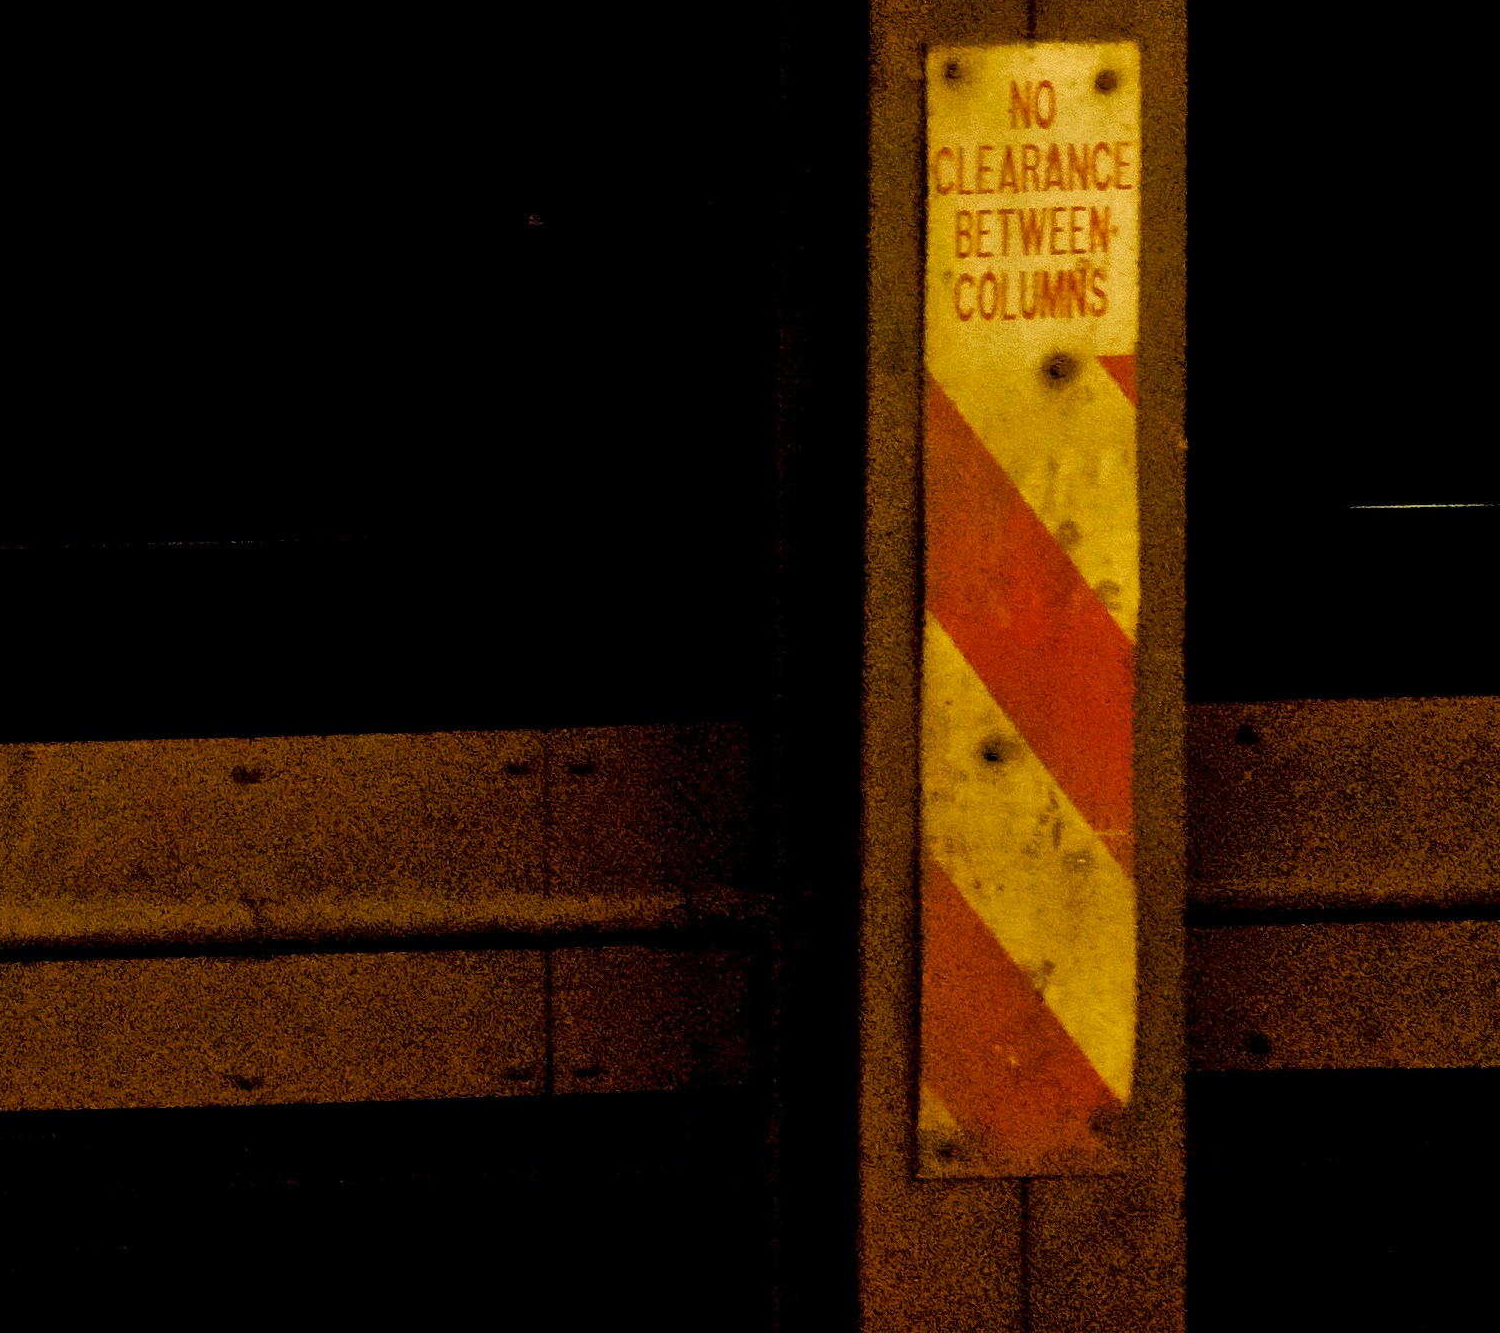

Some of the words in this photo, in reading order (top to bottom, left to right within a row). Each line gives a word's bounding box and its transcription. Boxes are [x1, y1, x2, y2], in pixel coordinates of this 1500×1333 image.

[1008, 80, 1056, 130] NO
[935, 141, 1134, 195] CLEARANCE
[955, 206, 1111, 258] BETWEEN
[954, 268, 1110, 321] COLUMNS
